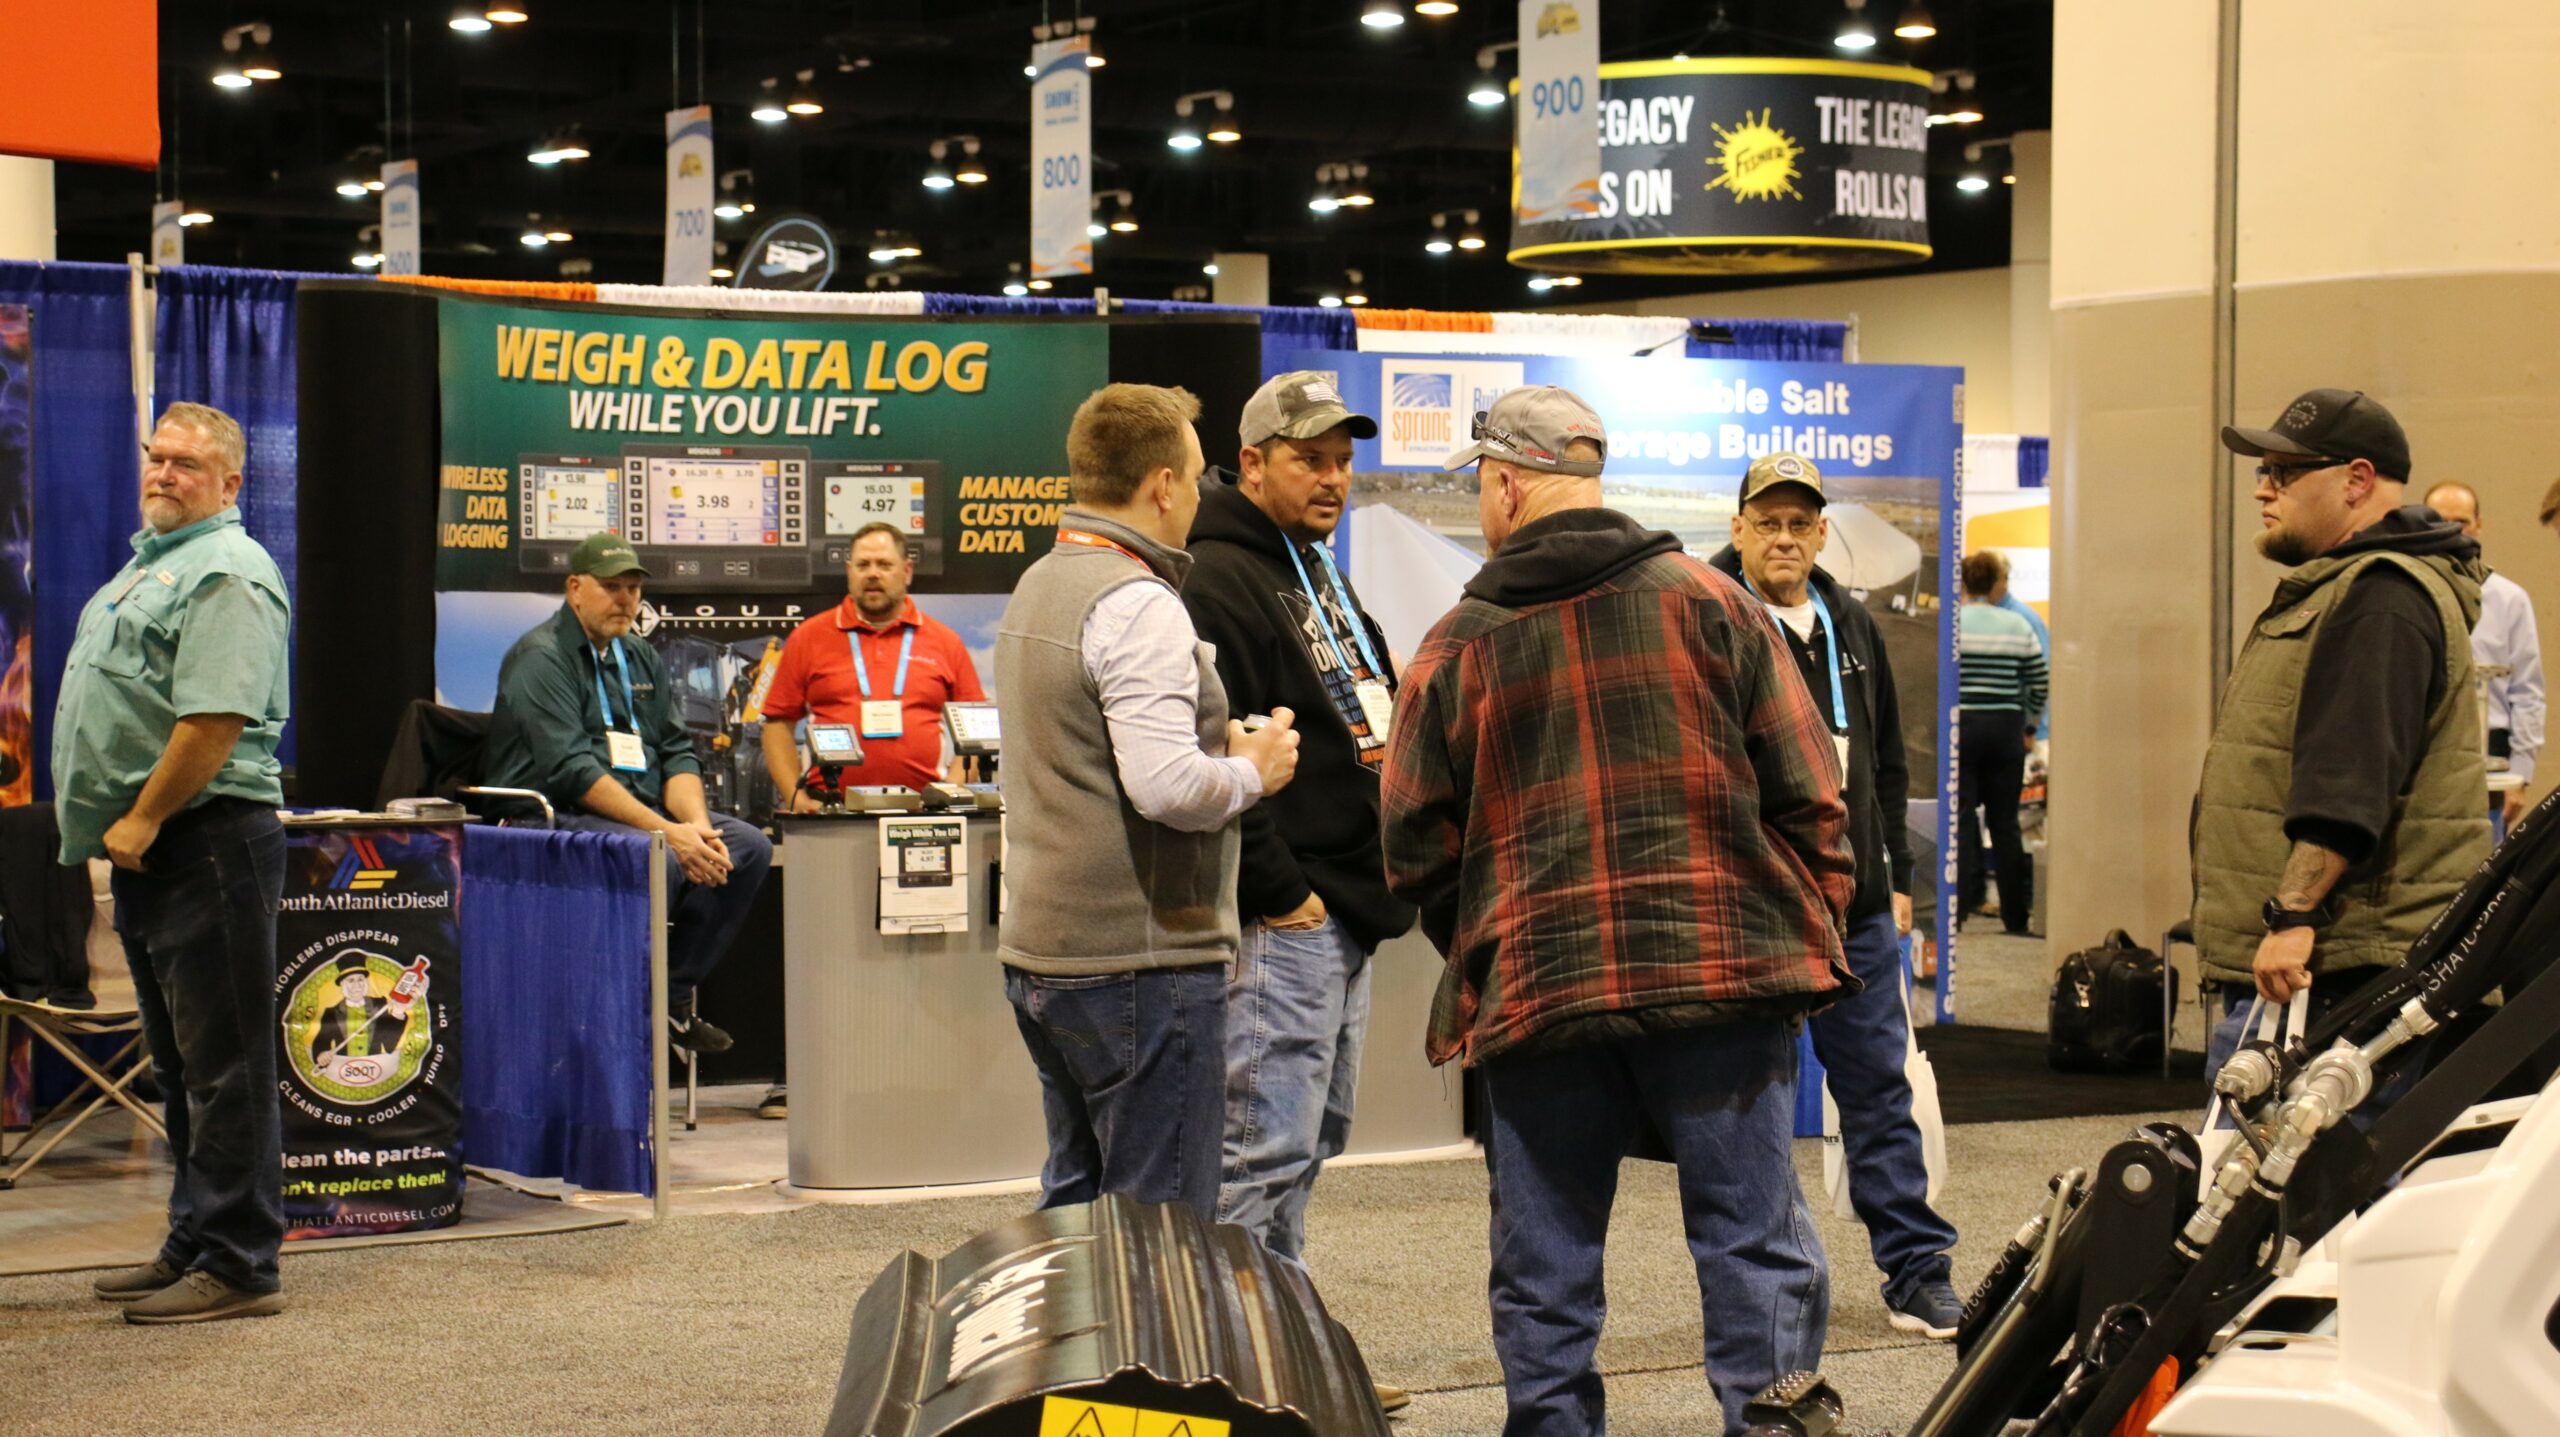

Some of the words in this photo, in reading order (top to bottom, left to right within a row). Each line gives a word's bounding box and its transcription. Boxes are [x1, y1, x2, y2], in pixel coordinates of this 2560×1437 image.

[1532, 76, 1584, 118] 900
[1597, 95, 1694, 147] EGACY
[1815, 96, 1870, 147] THE
[1043, 154, 1080, 188] 800
[1626, 168, 1672, 217] ON
[1836, 169, 1908, 220] ROLLS
[675, 209, 705, 237] 700
[497, 325, 647, 386] WEIGH
[651, 336, 694, 388] &
[701, 337, 853, 390] DATA
[864, 340, 989, 393] LOG
[1780, 380, 1851, 415] Salt
[570, 389, 685, 432] WHILE
[691, 395, 781, 436] YOU
[785, 397, 881, 437] LIFT.
[1392, 408, 1451, 452] sprung
[1606, 430, 1712, 467] orage
[1719, 423, 1893, 468] Buildings
[441, 464, 508, 492] WIRELESS
[864, 484, 894, 495] 15.03
[959, 476, 1070, 500] MANAGE
[466, 495, 508, 520] DATA
[565, 496, 588, 510] 2.02
[696, 494, 730, 509] 3.98
[861, 498, 896, 513] 4.97
[442, 523, 508, 549] LOGGING
[959, 530, 1025, 553] DATA
[660, 604, 802, 617] LOUP
[277, 890, 449, 912] outhAtlanticDiesel
[275, 942, 324, 994] ROBLEMS
[325, 929, 400, 946] DISAPPEAR
[279, 1079, 323, 1119] CLEANS
[325, 1113, 352, 1126] EGR
[367, 1094, 417, 1125] COOLER
[424, 1043, 444, 1086] TURBO
[281, 1152, 327, 1168] lean
[334, 1148, 371, 1165] the
[280, 1180, 316, 1196] on't
[319, 1177, 394, 1197] replace
[397, 1169, 447, 1189] them!
[285, 1203, 456, 1229] THATLANTICDIESEL.COM
